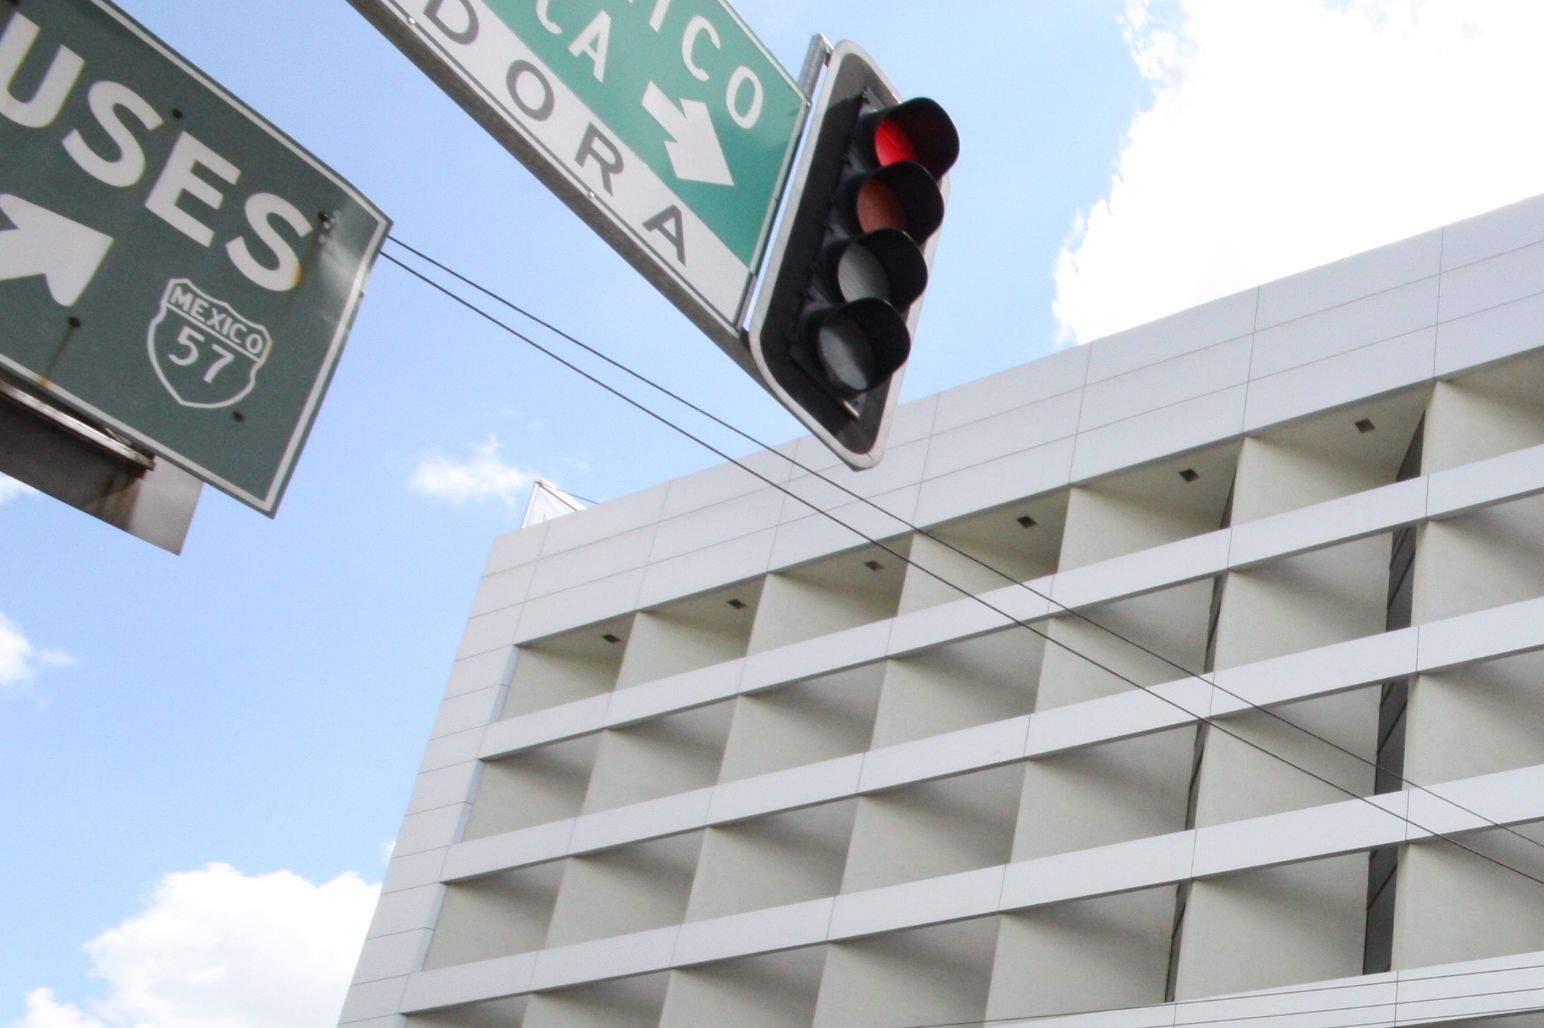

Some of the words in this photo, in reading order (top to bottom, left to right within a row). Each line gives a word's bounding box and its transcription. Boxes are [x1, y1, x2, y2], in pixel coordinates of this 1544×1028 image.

[626, 0, 763, 129] ICO
[0, 12, 312, 291] USES
[168, 326, 234, 384] 57
[169, 284, 263, 355] MEXICO
